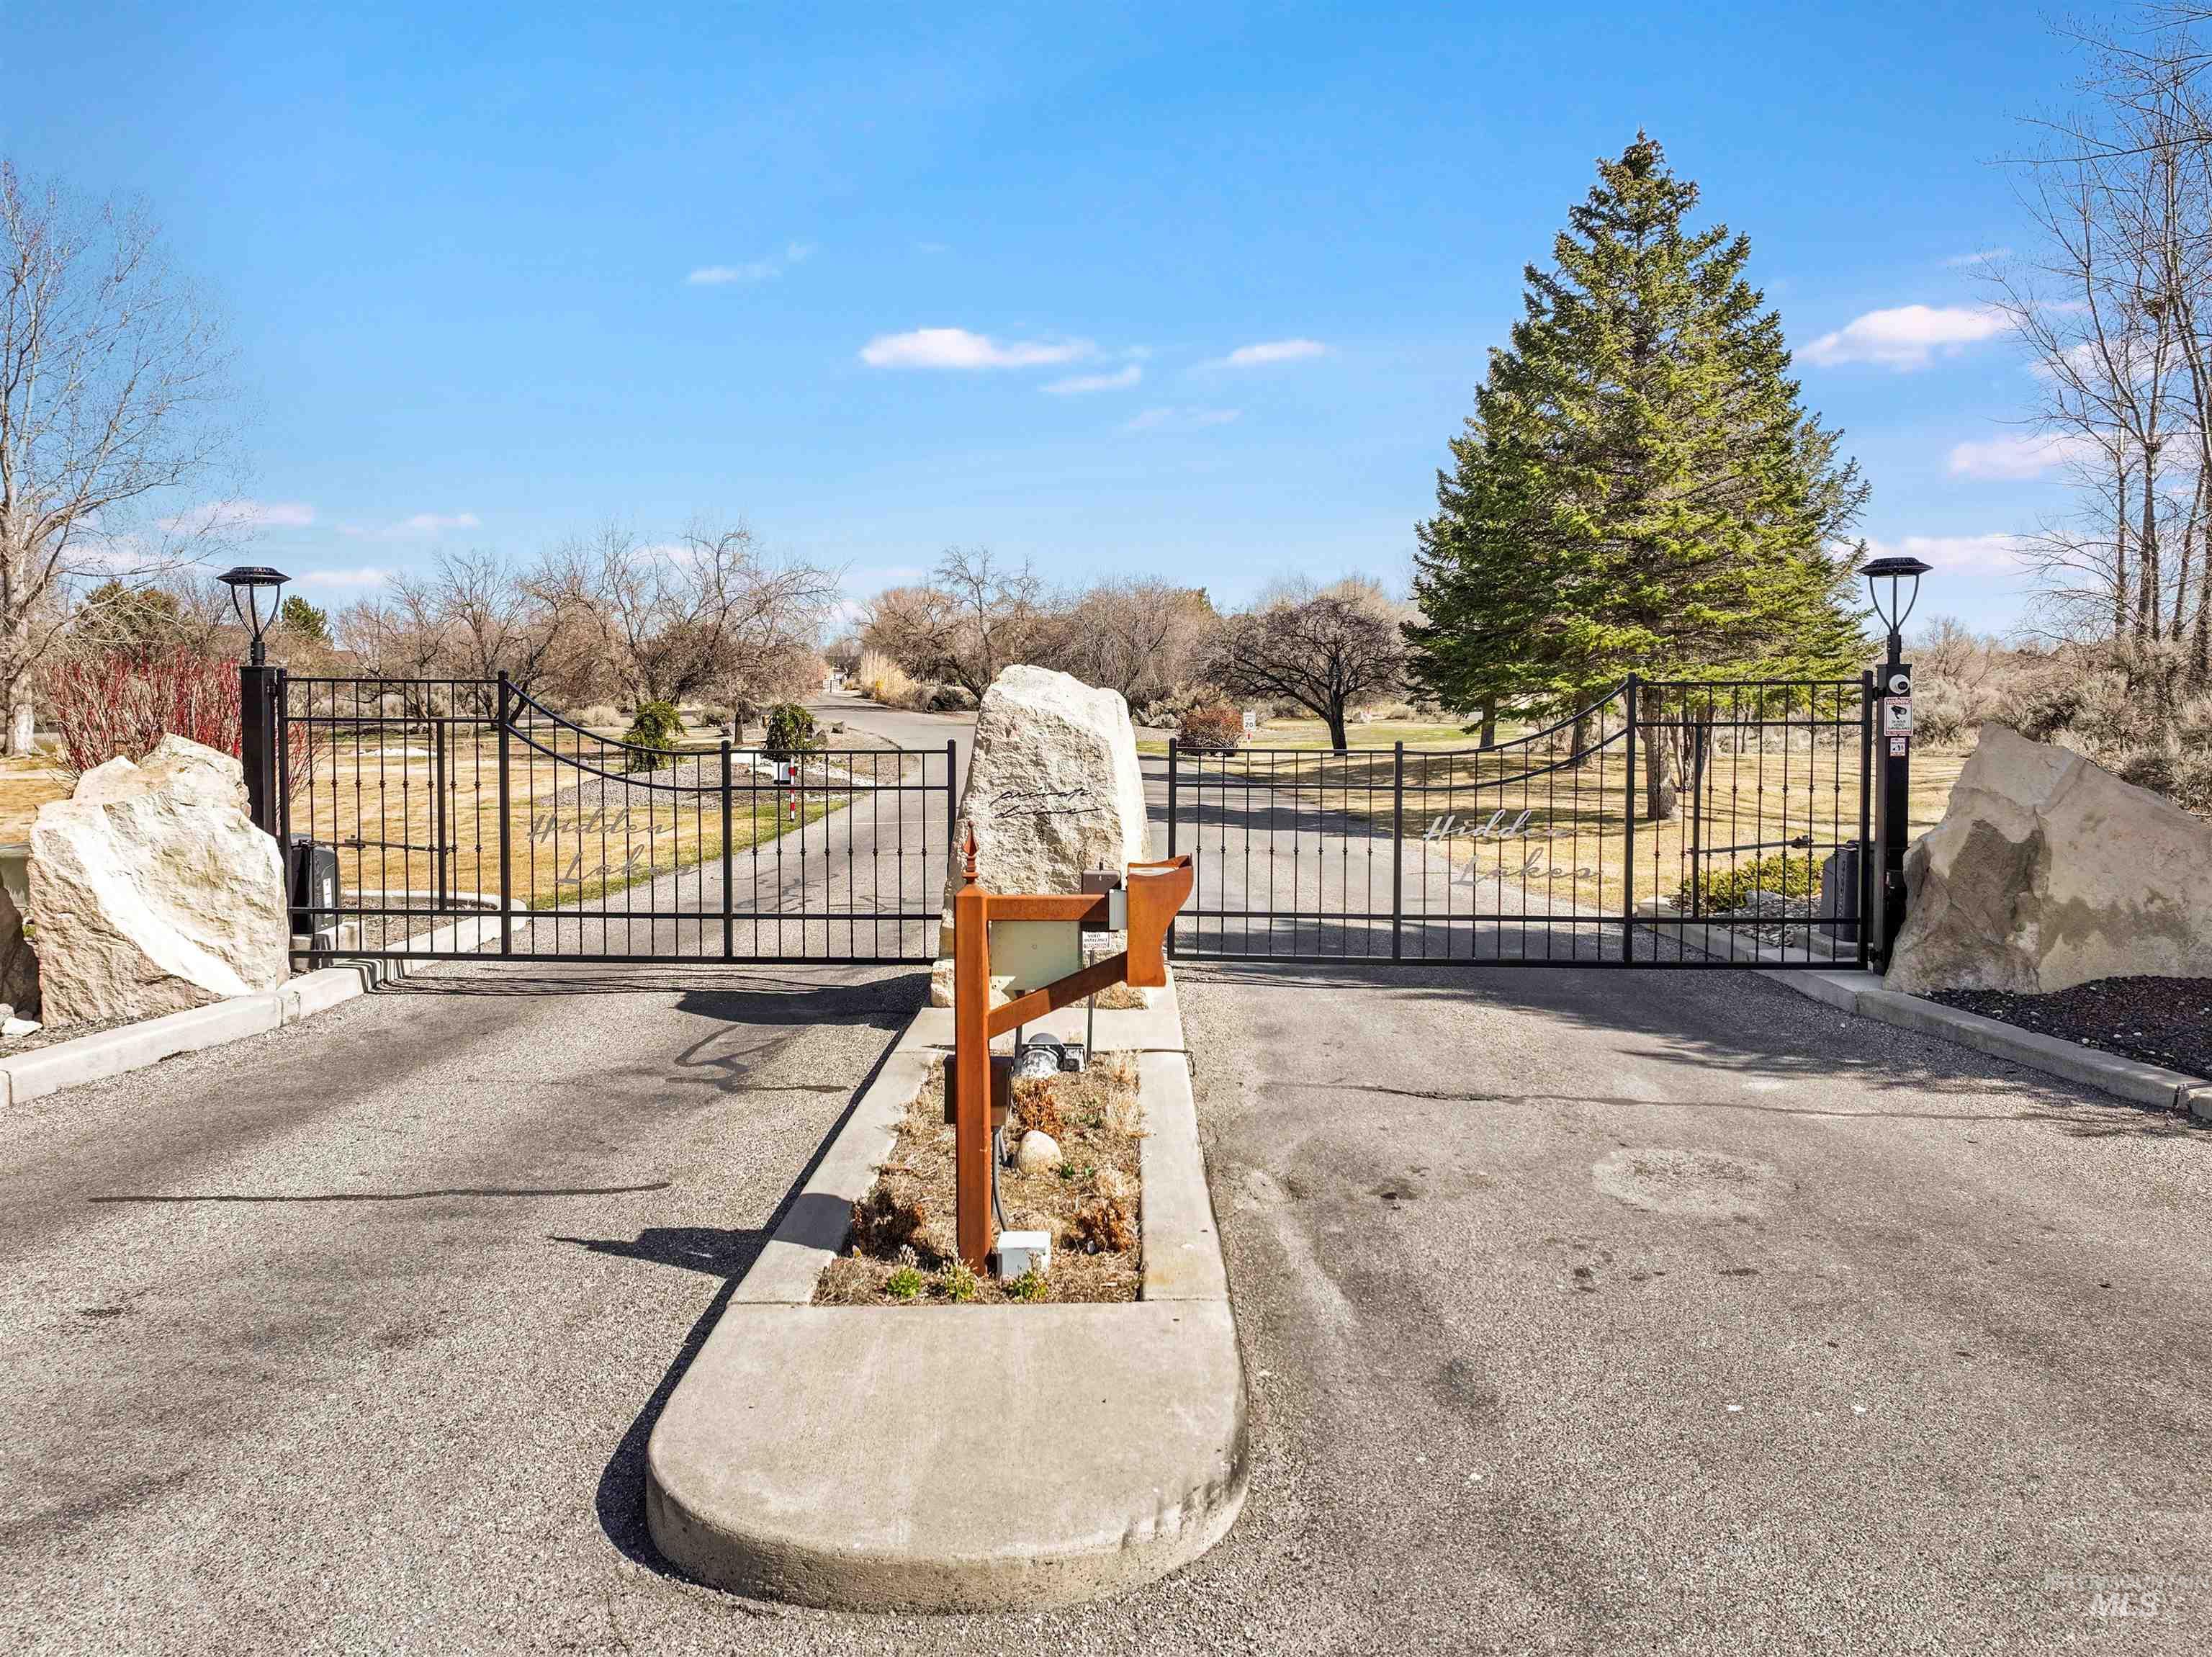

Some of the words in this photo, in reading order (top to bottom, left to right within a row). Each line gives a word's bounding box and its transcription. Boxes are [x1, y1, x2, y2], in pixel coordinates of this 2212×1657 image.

[526, 806, 675, 843] Hidden
[1423, 809, 1578, 845] Hidden
[555, 843, 702, 884] Lakes
[1450, 846, 1604, 886] Lakes
